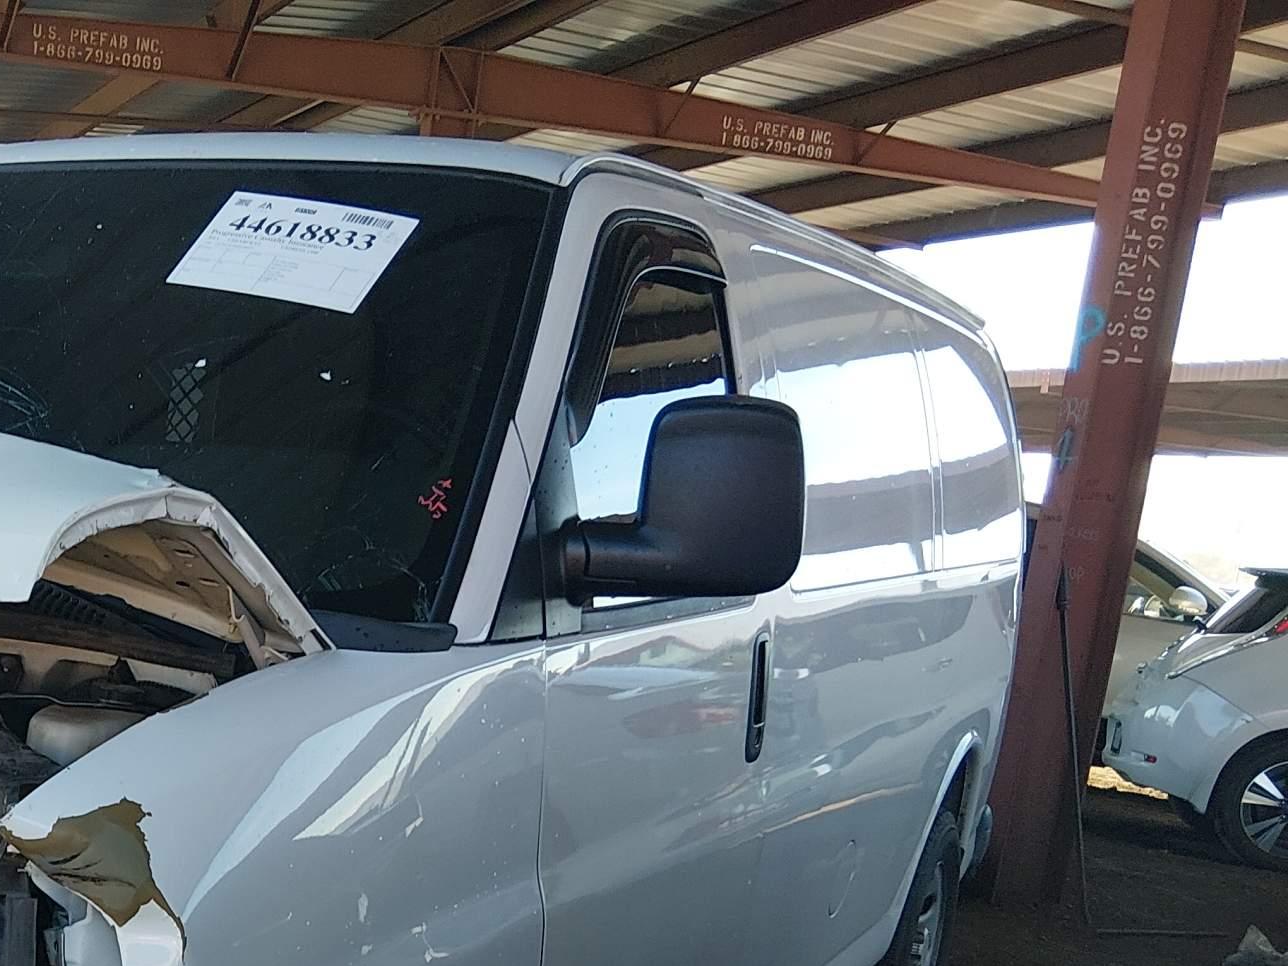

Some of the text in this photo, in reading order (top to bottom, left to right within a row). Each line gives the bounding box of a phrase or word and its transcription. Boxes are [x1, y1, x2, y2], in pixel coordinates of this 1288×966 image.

[32, 23, 164, 54] U.S. PREFAB INC.
[33, 40, 162, 70] 1-866-799-0969
[722, 115, 834, 145] U.S. PREFAB INC.
[228, 214, 378, 252] 44618833
[1101, 119, 1165, 365] U.S. PREFAB INC.
[1124, 122, 1187, 363] 1-866-799-0969
